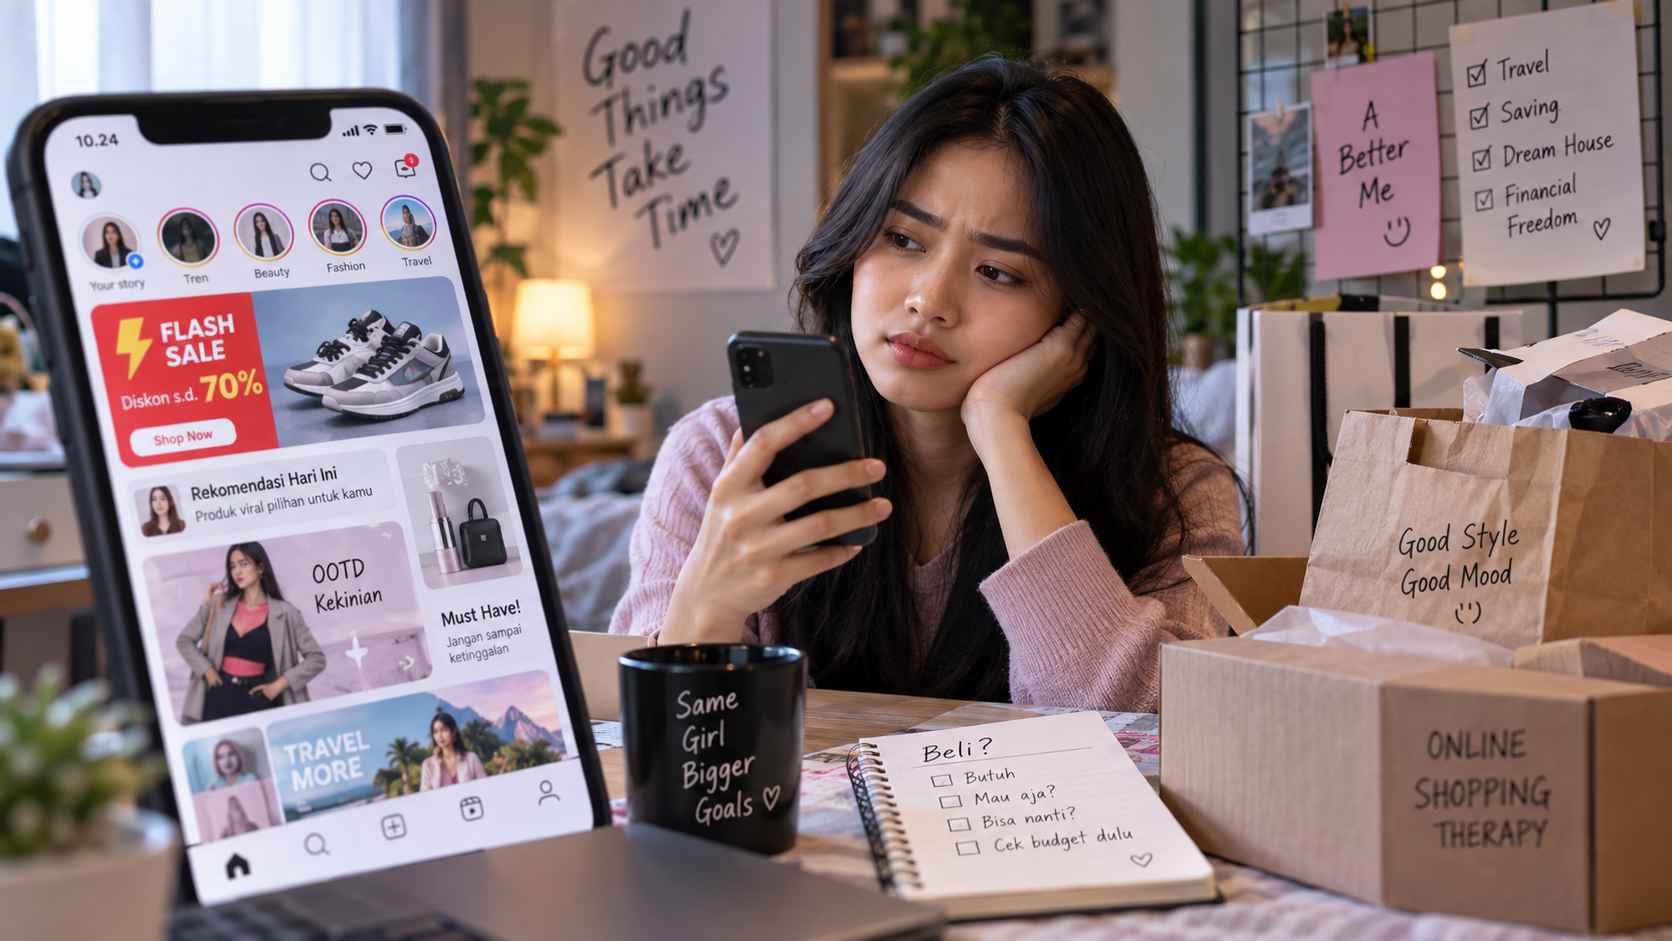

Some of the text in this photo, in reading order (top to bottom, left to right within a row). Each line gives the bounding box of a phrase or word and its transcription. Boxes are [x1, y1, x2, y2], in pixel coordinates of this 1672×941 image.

[582, 7, 691, 89] Good
[1498, 49, 1549, 82] Travel
[589, 64, 729, 146] Things
[1362, 101, 1379, 131] A
[1501, 97, 1559, 124] Saving
[75, 133, 119, 148] 10.24
[1503, 133, 1614, 167] Dream House
[1339, 139, 1410, 176] Better
[589, 140, 690, 209] Take
[1359, 180, 1394, 209] Me
[1505, 173, 1577, 207] Financial
[635, 177, 740, 250] Time
[1508, 209, 1578, 238] Freedom
[254, 267, 290, 281] Beauty
[326, 261, 365, 273] Fashion
[401, 256, 432, 268] Travel
[89, 278, 145, 292] Your story
[184, 273, 208, 284] Tren
[160, 313, 235, 343] FLASH
[166, 339, 226, 367] SALE
[120, 368, 263, 410] Diskon s.d. 70%
[154, 430, 213, 447] Shop Now
[191, 466, 338, 501] Rekomendasi Hari Ini
[195, 486, 373, 522] Produk viral pilihan untuk kamu
[1399, 519, 1520, 559] Good Style
[312, 558, 365, 584] OOTD
[1401, 558, 1513, 599] Good Mood
[314, 588, 383, 615] Kekinian
[441, 599, 521, 628] Must Have!
[446, 624, 523, 651] Jangan sampai
[449, 644, 510, 665] ketinggalan
[676, 690, 739, 719] Same
[283, 729, 371, 765] TRAVEL
[682, 720, 724, 755] Girl
[1426, 729, 1526, 760] ONLINE
[291, 756, 364, 791] MORE
[682, 753, 756, 794] Bigger
[964, 768, 1016, 785] Butuh
[974, 784, 1056, 805] Mau aja?
[1414, 775, 1551, 810] SHOPPING
[695, 791, 753, 827] Goals
[983, 806, 1076, 829] Bisa nanti?
[994, 827, 1134, 853] Cek budget dulu
[1434, 819, 1549, 849] THERAPY
